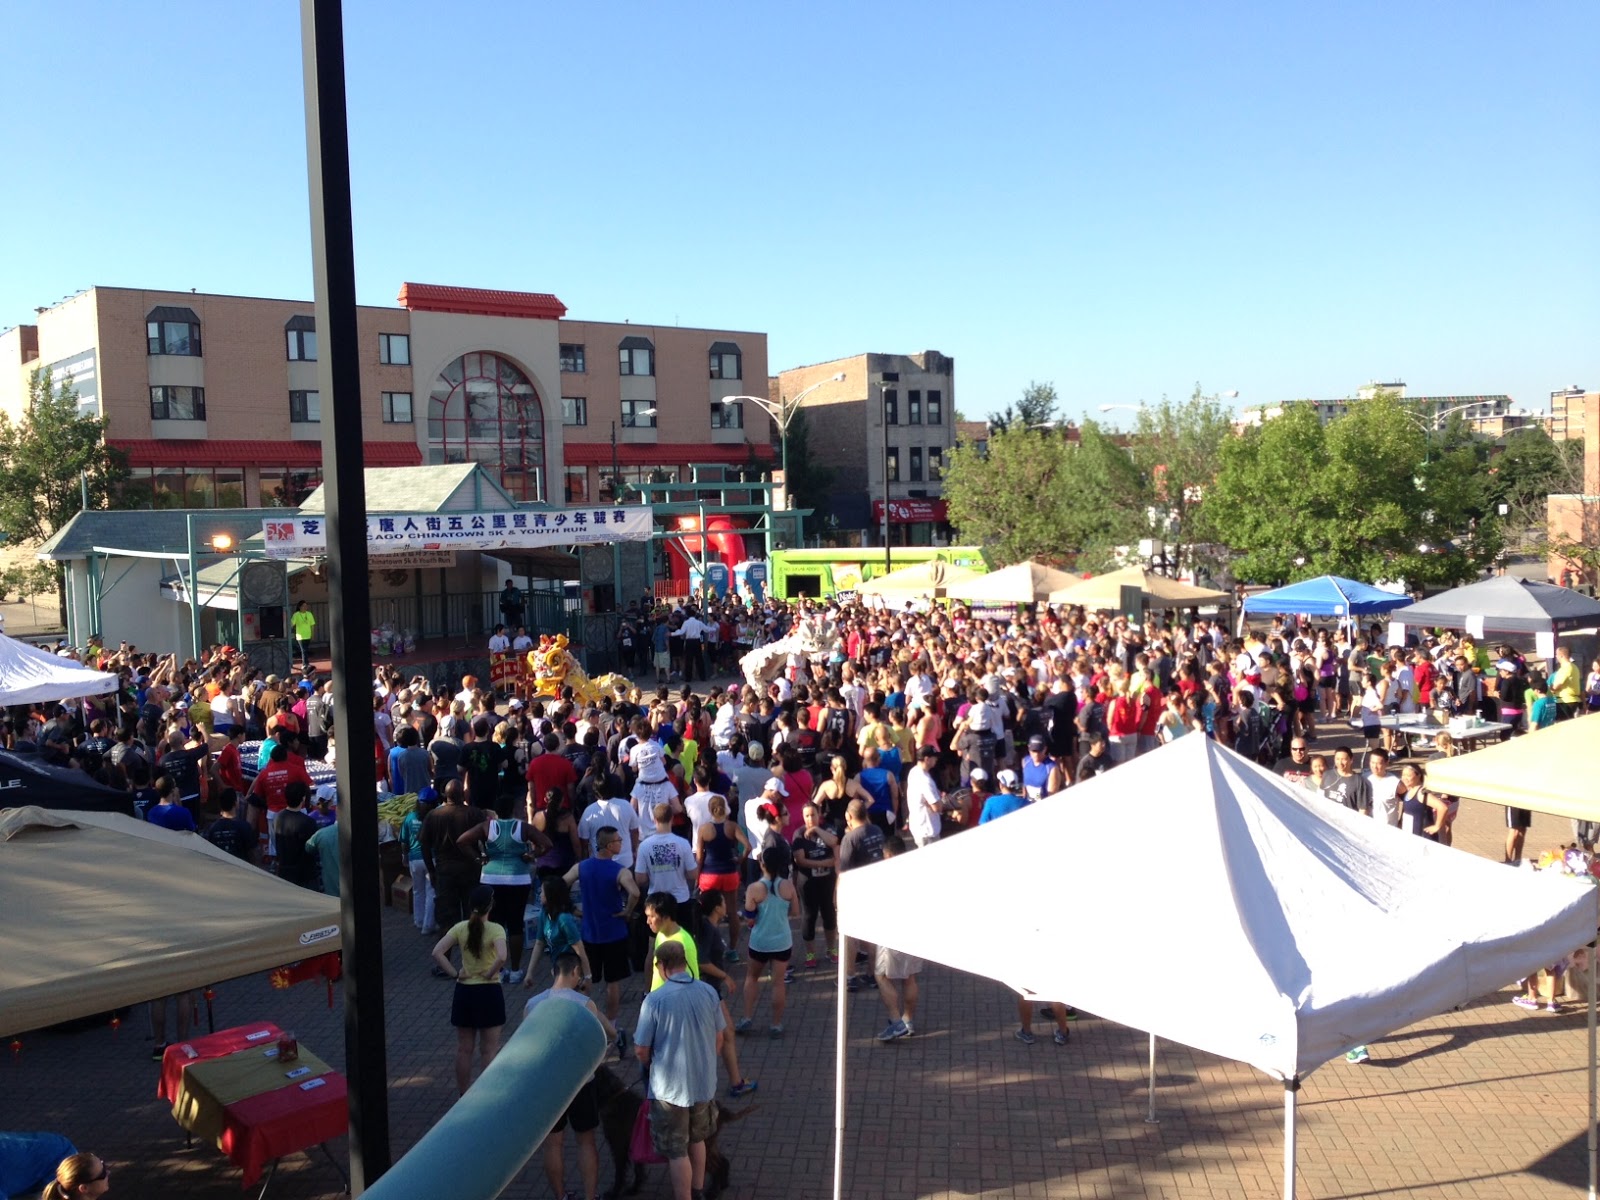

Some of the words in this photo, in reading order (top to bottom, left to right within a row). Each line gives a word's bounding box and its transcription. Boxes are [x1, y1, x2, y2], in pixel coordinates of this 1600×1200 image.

[302, 510, 626, 535] 芝唐人街五公里暨青少年競賽
[408, 530, 484, 539] CHINATOWN
[831, 718, 845, 734] 13
